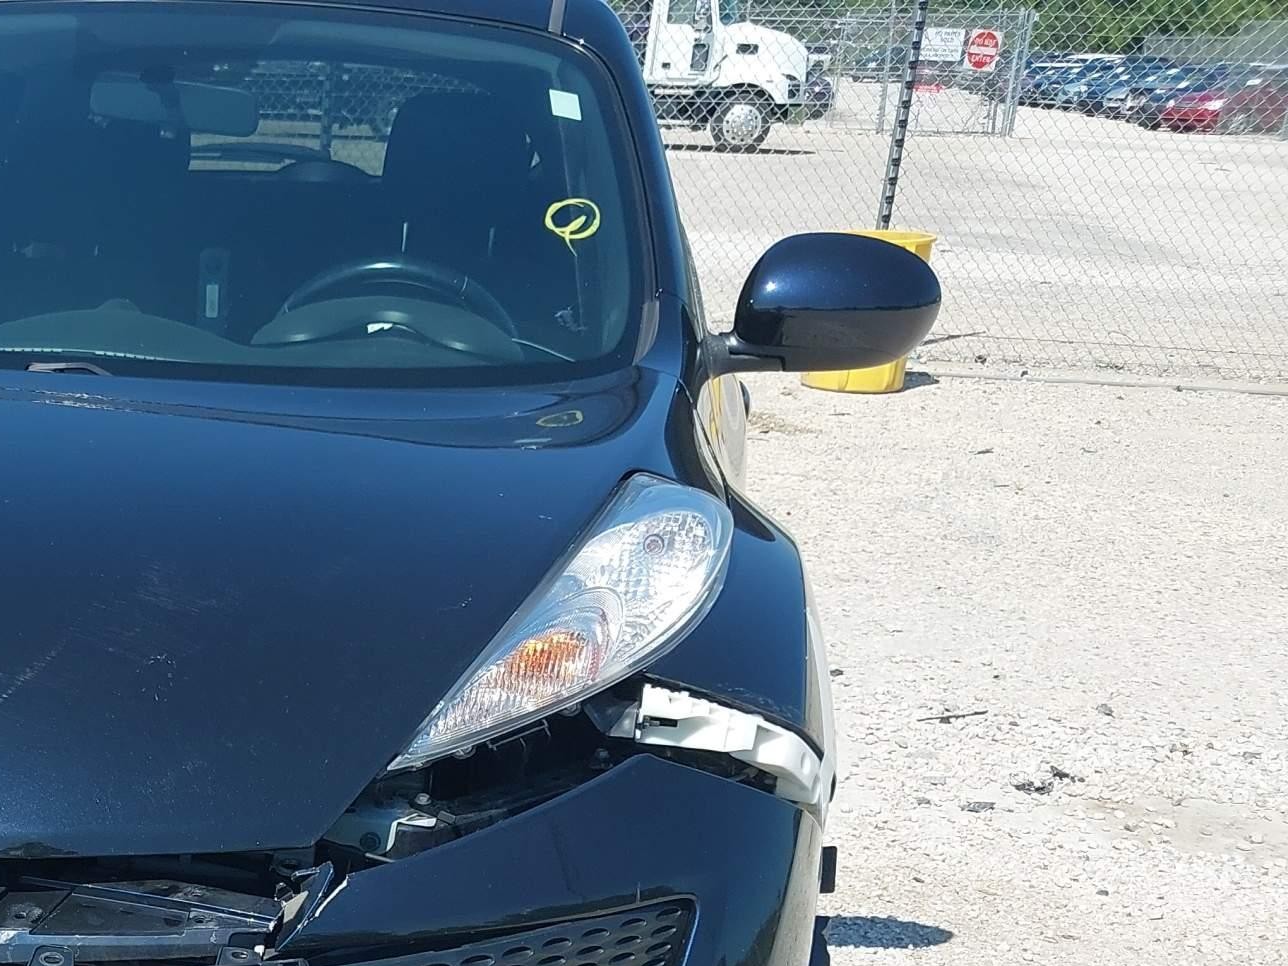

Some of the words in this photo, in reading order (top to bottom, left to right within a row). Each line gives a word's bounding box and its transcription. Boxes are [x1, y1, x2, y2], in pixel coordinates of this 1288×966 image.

[974, 37, 983, 45] DO
[984, 38, 996, 47] NOT
[971, 55, 991, 63] ENTER
